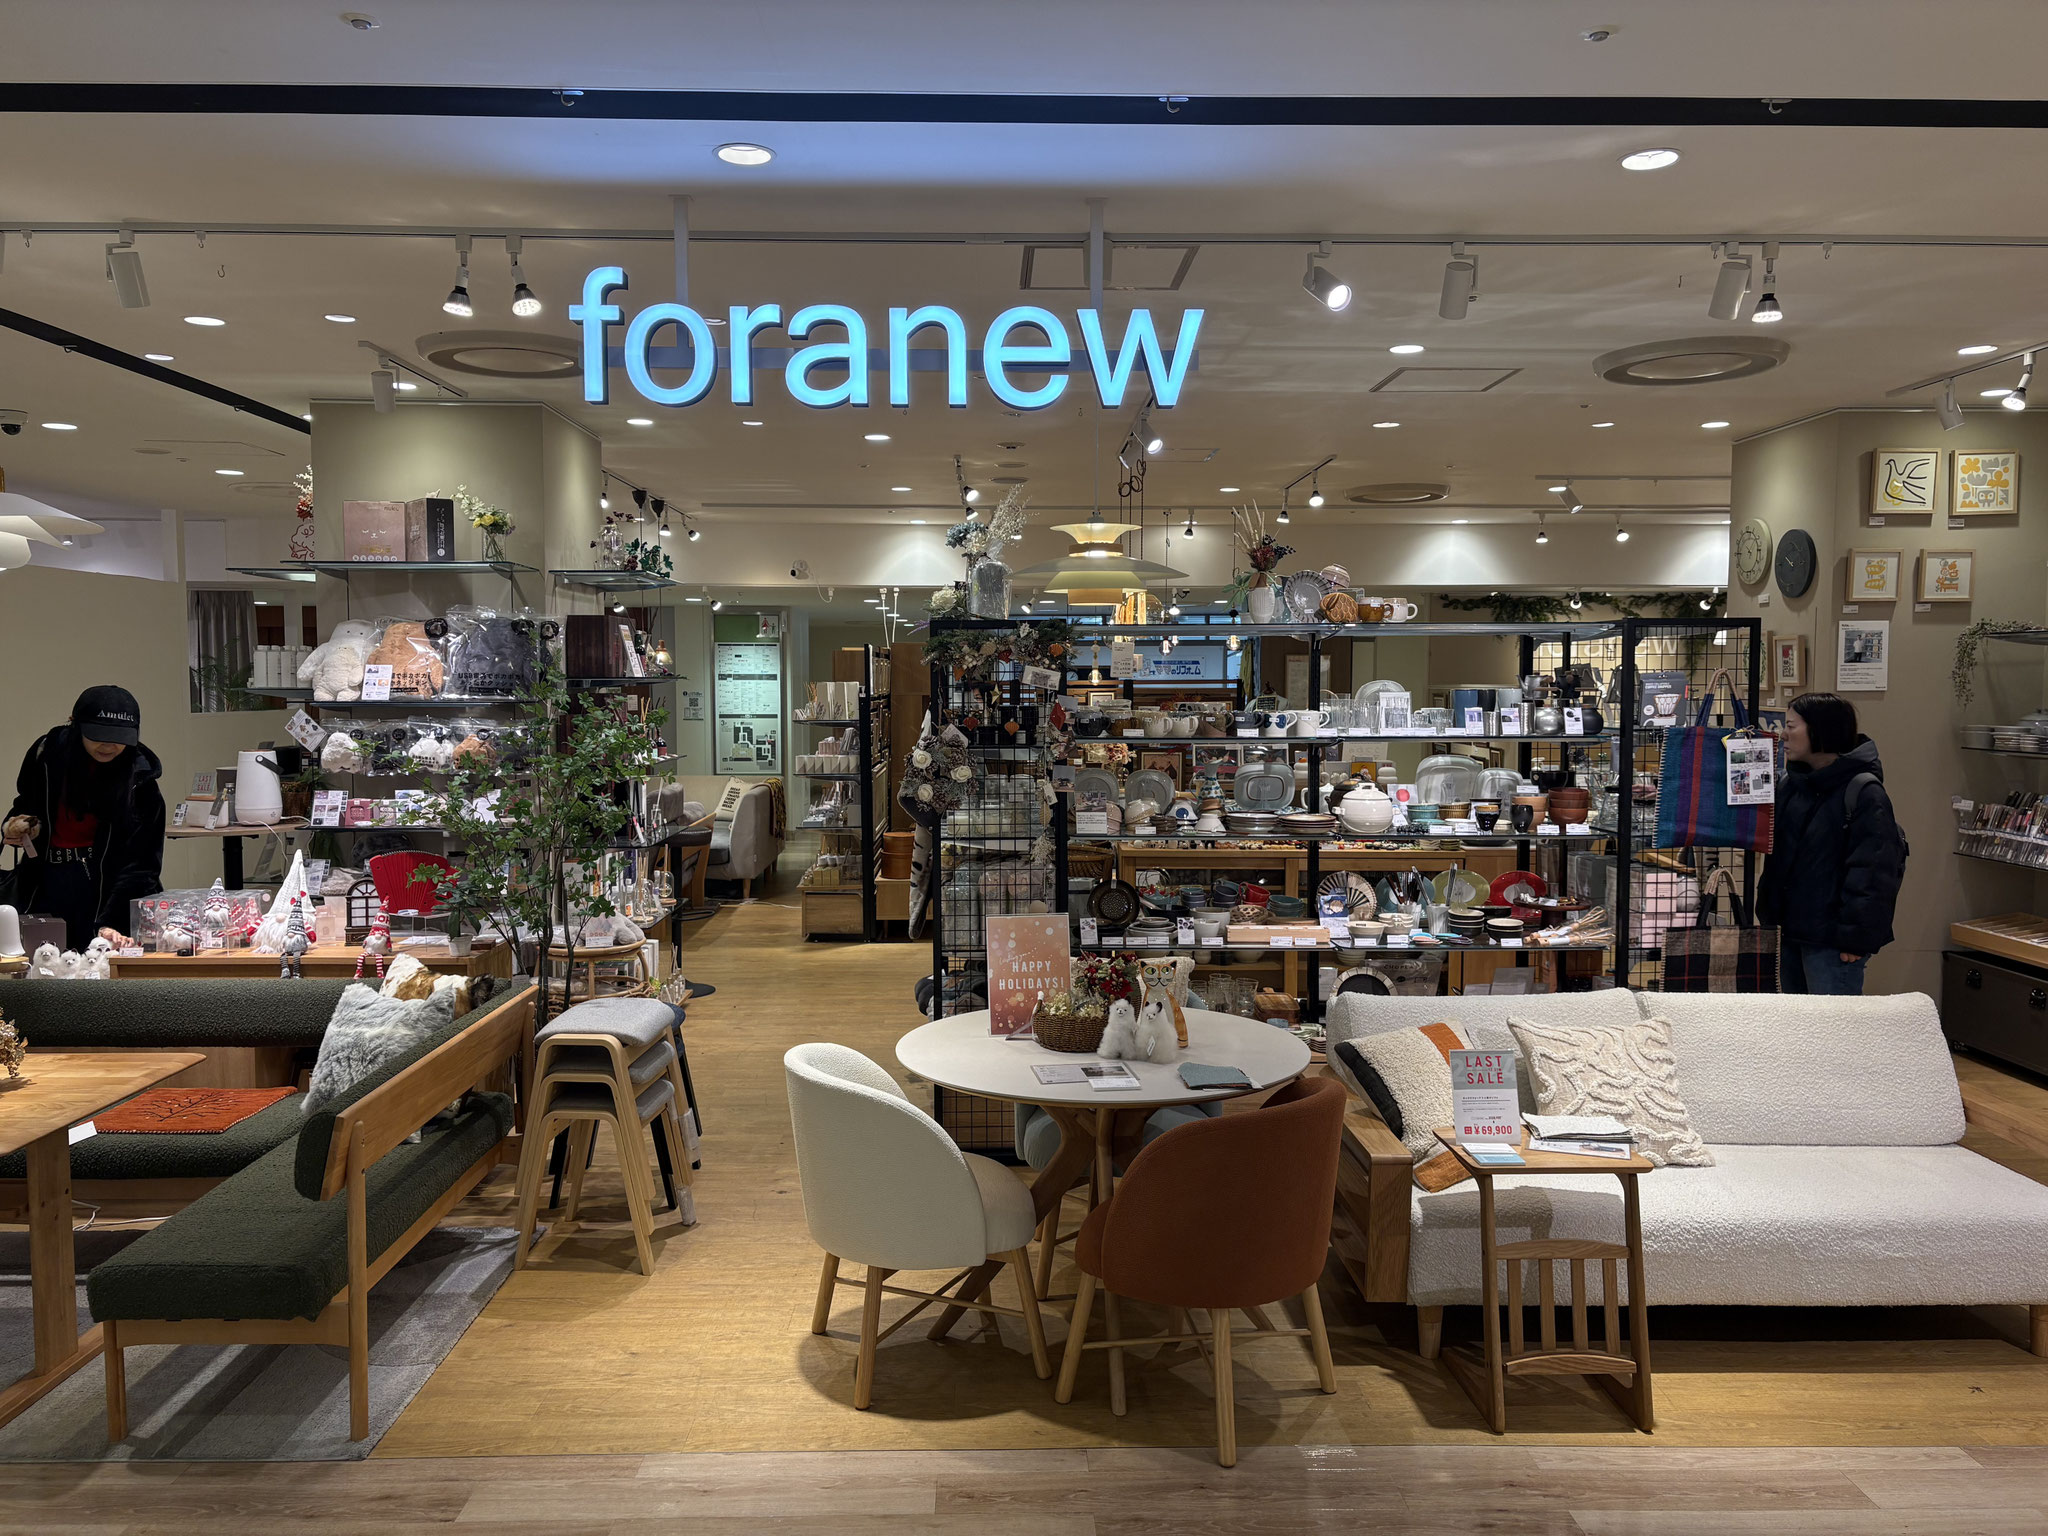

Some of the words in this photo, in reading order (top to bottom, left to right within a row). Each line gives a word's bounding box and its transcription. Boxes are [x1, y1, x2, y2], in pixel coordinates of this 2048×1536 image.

[568, 265, 1205, 411] foranew
[97, 709, 134, 722] Amulet
[198, 775, 212, 783] LAST
[197, 784, 212, 792] SALE
[1012, 960, 1051, 973] HAPPY
[998, 976, 1065, 991] HOLIDAYS!
[1465, 1055, 1502, 1068] LAST
[1466, 1072, 1504, 1085] SALE
